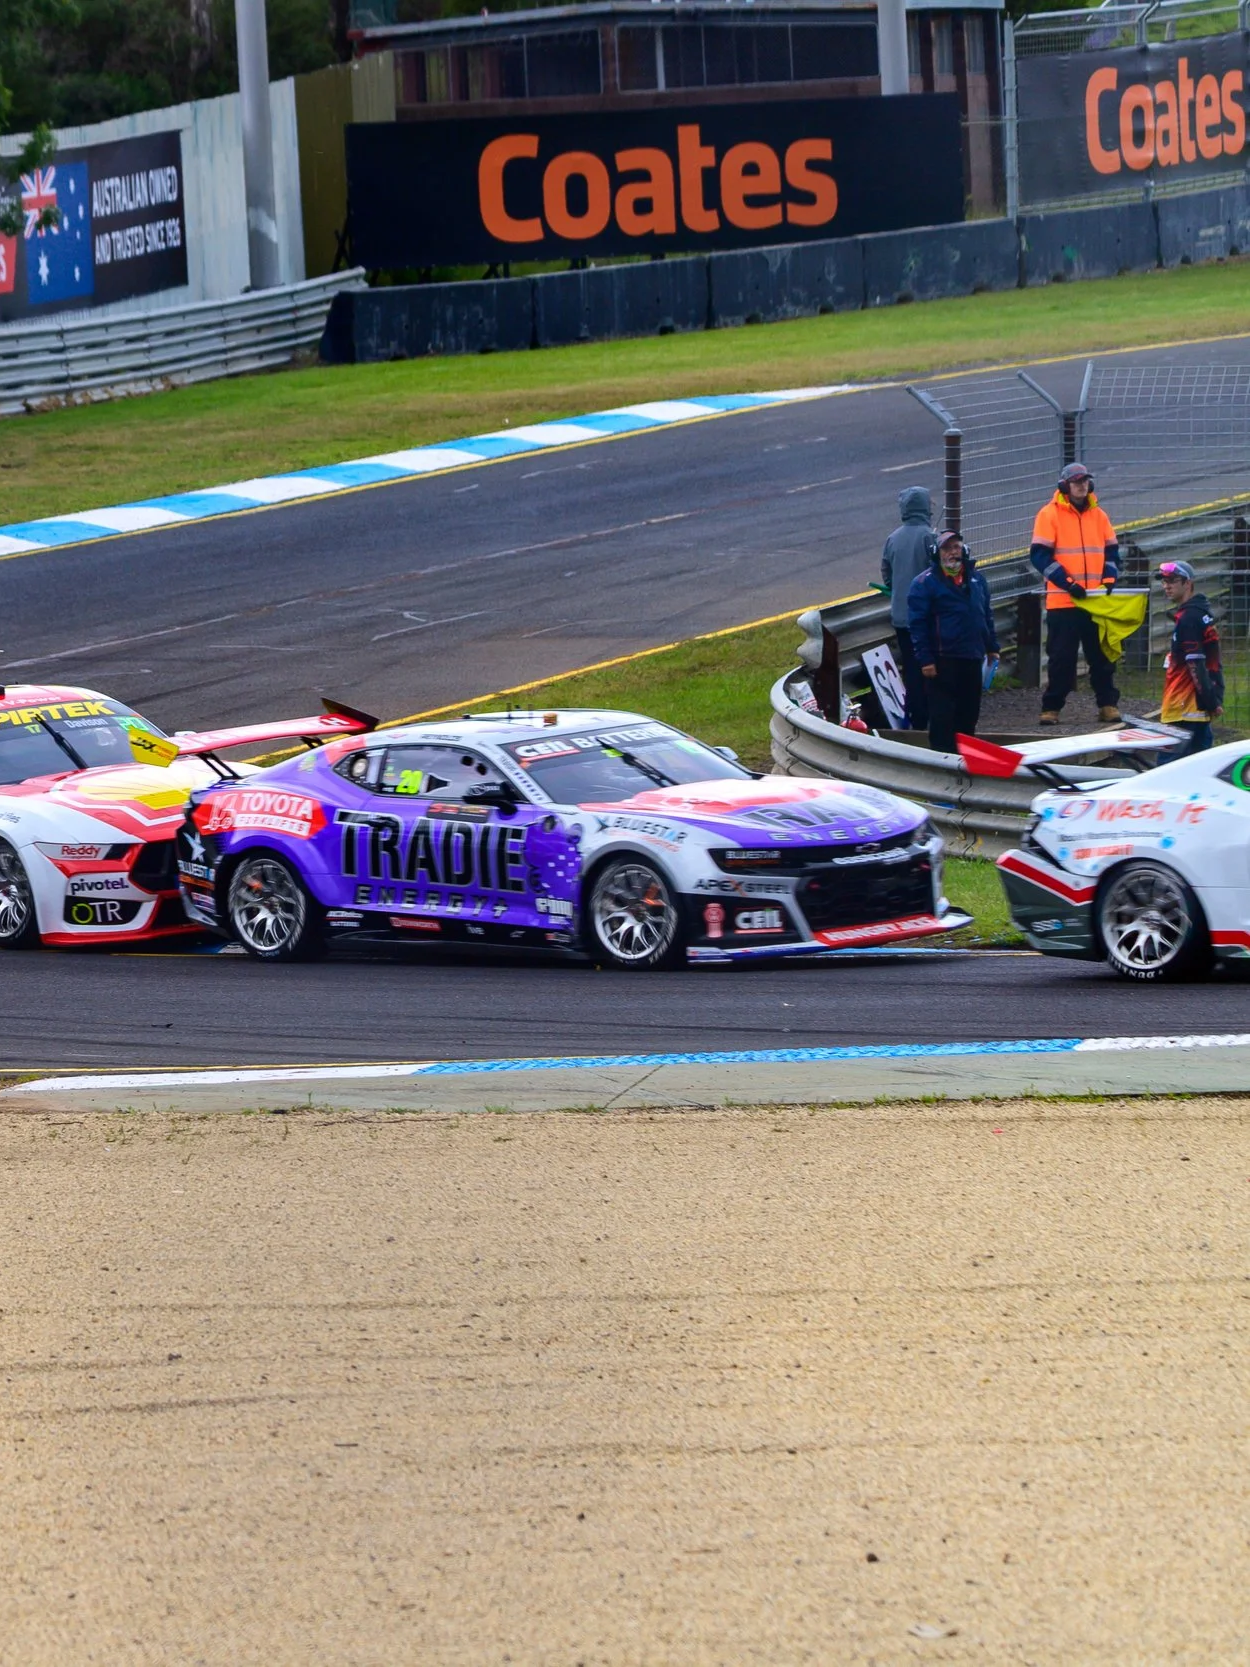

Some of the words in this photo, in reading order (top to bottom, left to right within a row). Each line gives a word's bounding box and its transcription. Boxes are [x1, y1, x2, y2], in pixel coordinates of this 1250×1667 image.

[1085, 57, 1247, 175] Coates
[92, 178, 148, 218] AUSTRALIAN
[149, 166, 178, 204] OWNED
[478, 124, 838, 243] Coates
[95, 233, 112, 264] AND
[113, 227, 144, 260] TRUSTED
[145, 222, 165, 254] SINCE
[165, 218, 181, 248] 1926
[63, 717, 111, 729] Davison
[242, 793, 313, 819] TOYOTA
[61, 845, 101, 858] Reddy
[334, 808, 527, 894] TRADIE
[72, 901, 122, 924] OTR
